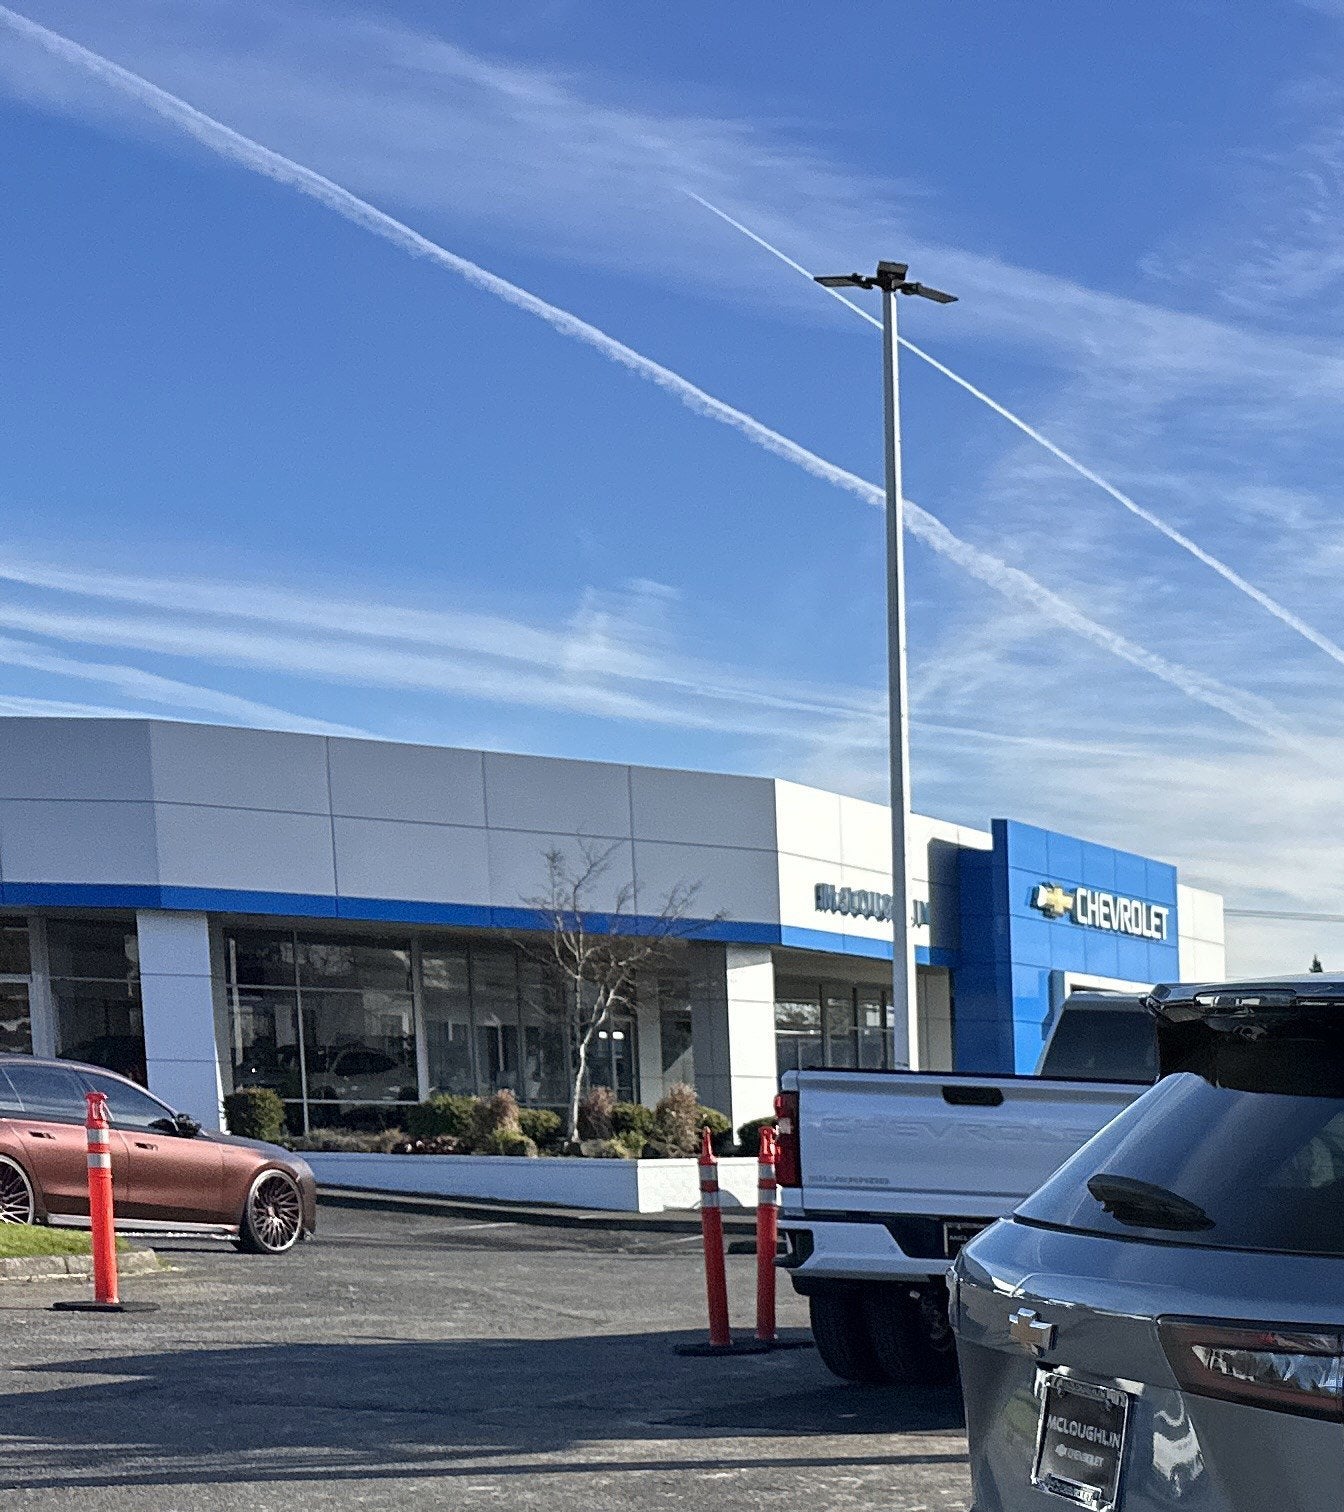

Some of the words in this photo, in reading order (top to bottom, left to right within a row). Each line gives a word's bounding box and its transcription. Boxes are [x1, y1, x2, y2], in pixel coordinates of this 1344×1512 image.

[1076, 887, 1169, 941] CHEVROLET
[819, 1117, 1099, 1144] CHEVROLE
[1047, 1413, 1120, 1448] MCLOUGHLIN
